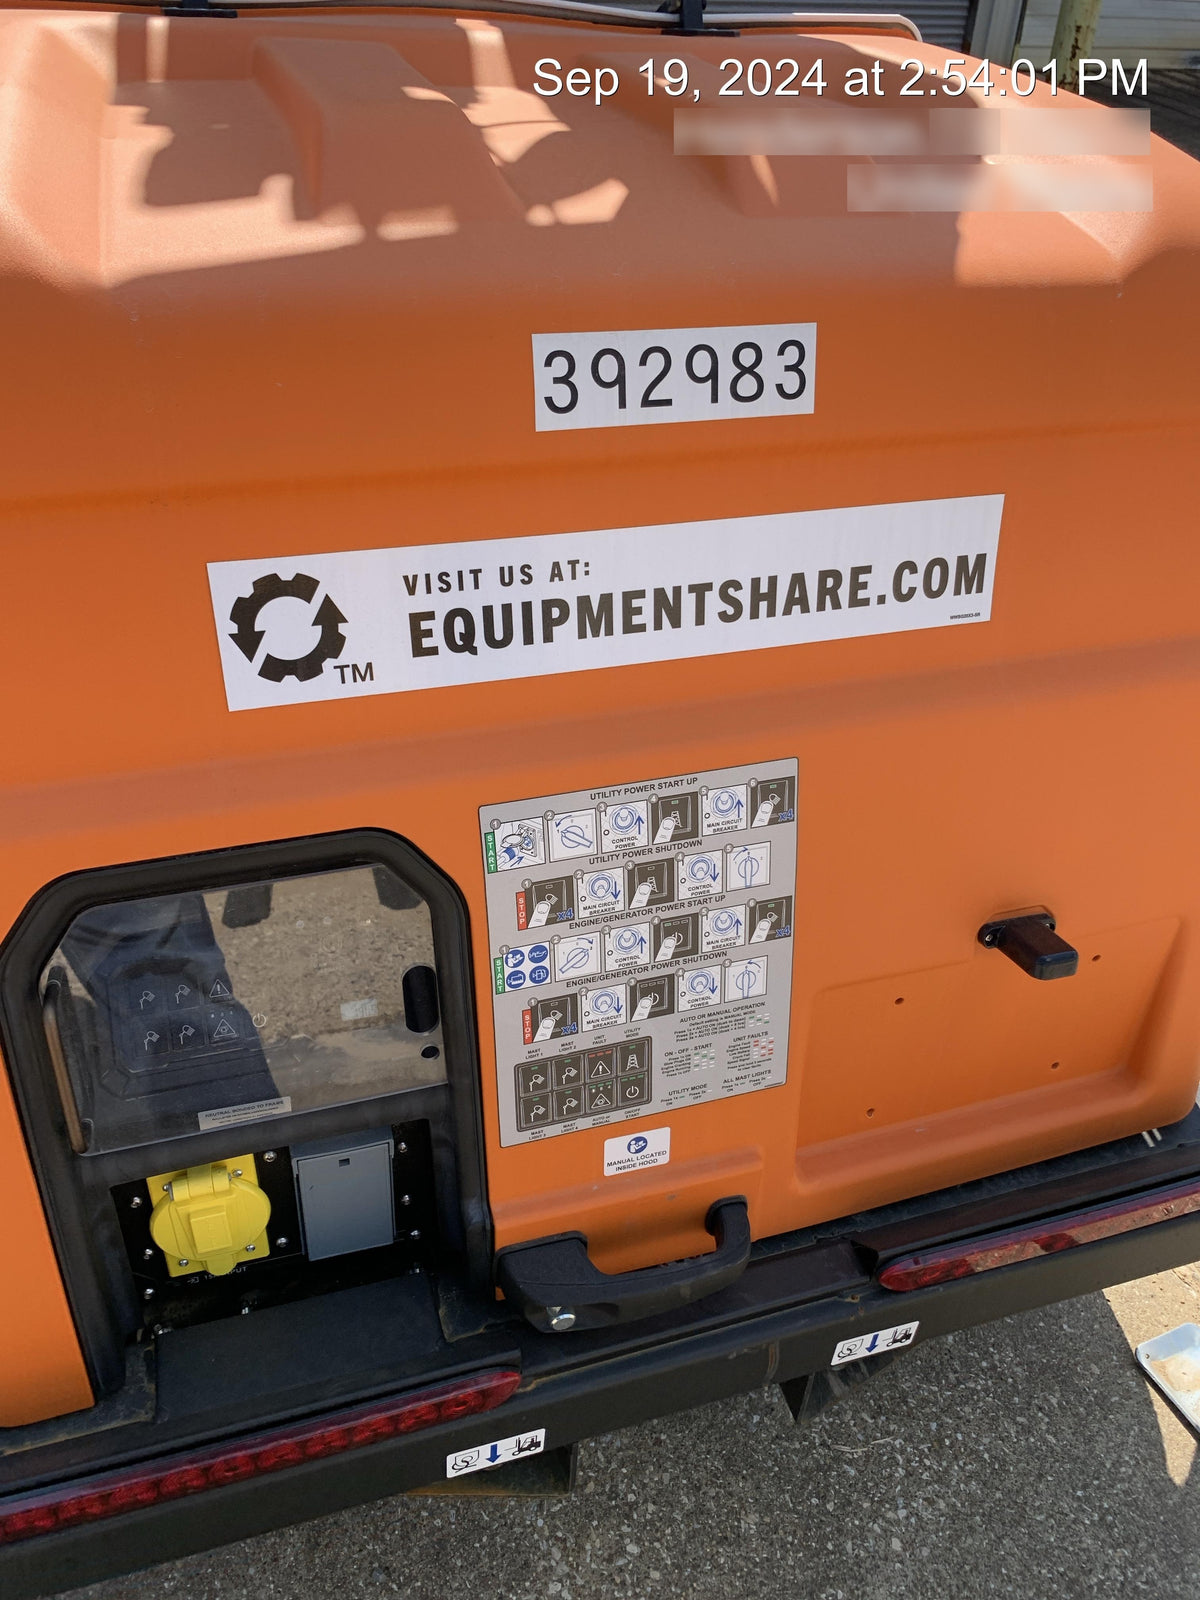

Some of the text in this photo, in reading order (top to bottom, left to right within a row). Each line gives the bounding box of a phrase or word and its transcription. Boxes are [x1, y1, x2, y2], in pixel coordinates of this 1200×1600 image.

[544, 340, 806, 414] 392983
[402, 558, 590, 596] VISIT US AT:
[409, 553, 987, 657] EQUIPMENTSHARE.COM
[334, 662, 374, 684] TM
[590, 789, 622, 800] UTILITY
[624, 784, 655, 795] POWER
[658, 779, 684, 790] START
[712, 825, 738, 833] BREAKER
[612, 836, 638, 844] CONTROL
[589, 840, 702, 865] UTILITY POWER SHUTDOWN
[688, 884, 713, 892] CONTROL
[598, 900, 620, 908] CIRCUIT
[557, 908, 573, 920] x4
[569, 910, 652, 929] ENGINE/GENERATOR
[656, 903, 685, 913] POWER
[688, 898, 716, 908] START
[589, 907, 616, 916] BREAKER
[720, 936, 741, 944] CIRCUIT
[566, 951, 728, 988] ENGINE/GENERATOR POWER SHUTDOWN
[707, 1009, 731, 1018] MANUAL
[733, 1002, 766, 1012] OPERATION
[592, 1020, 618, 1028] BREAKER
[601, 1014, 622, 1022] CIRCUIT
[562, 1022, 577, 1035] x4
[748, 1031, 768, 1040] FAULTS
[752, 1070, 772, 1078] LIGHTS
[669, 1088, 690, 1096] UTILITY
[607, 1150, 666, 1167] MANUAL LOCATED
[616, 1158, 658, 1171] INSIDE HOOD
